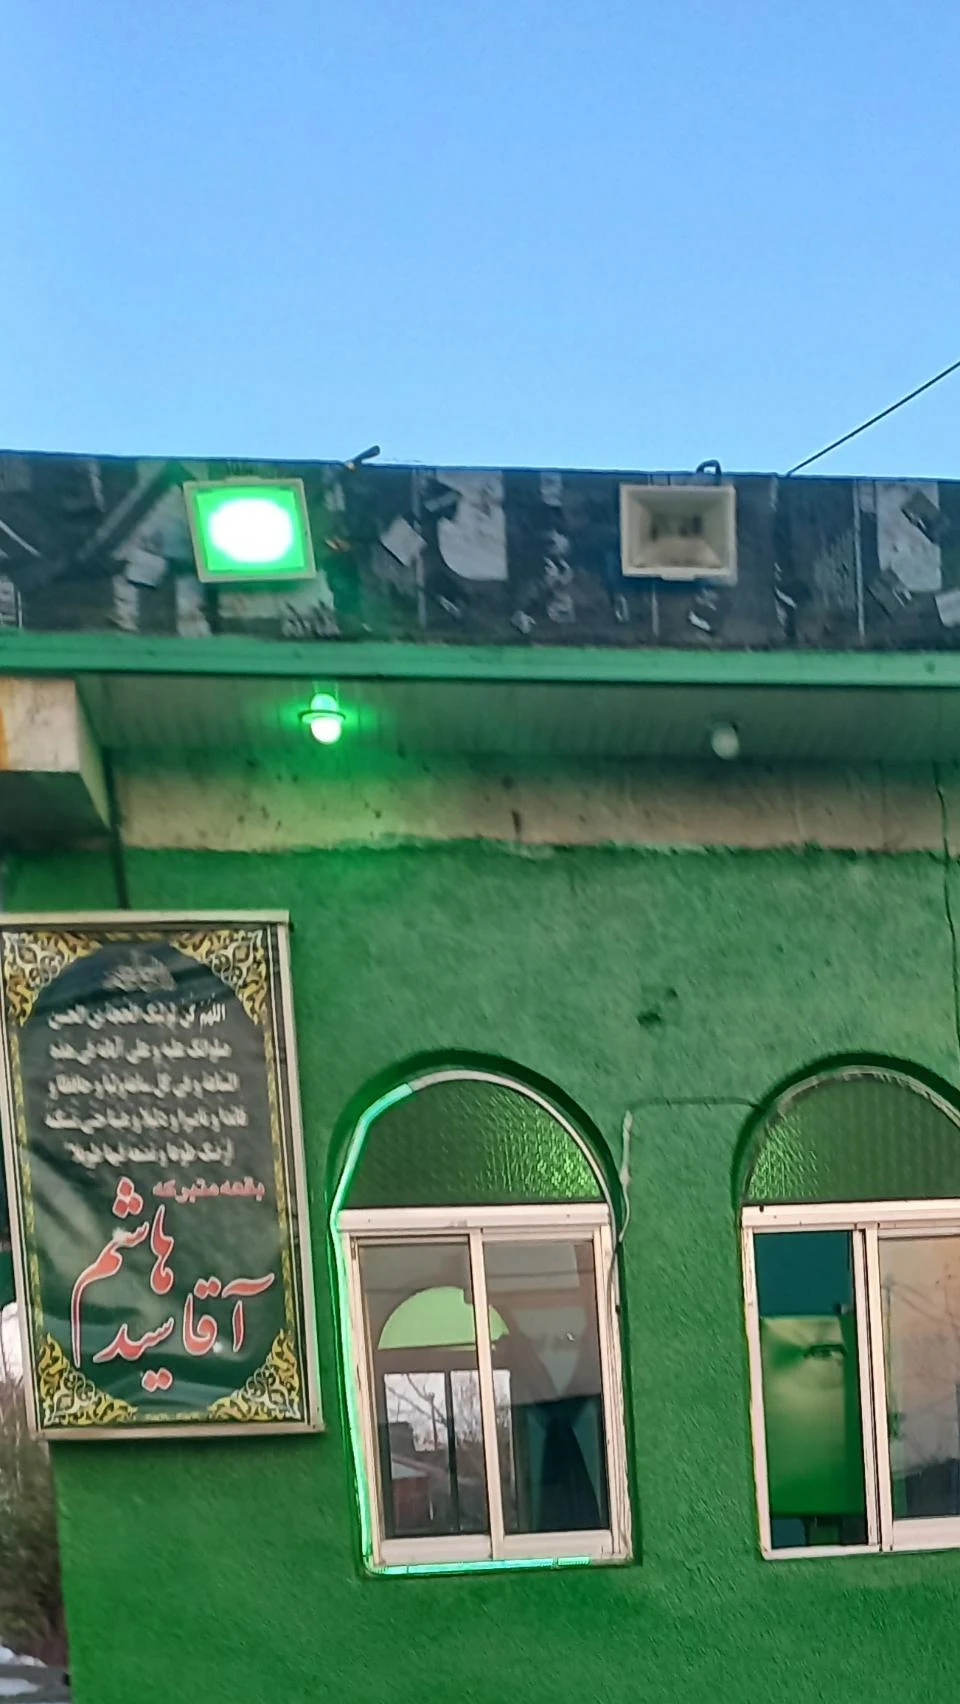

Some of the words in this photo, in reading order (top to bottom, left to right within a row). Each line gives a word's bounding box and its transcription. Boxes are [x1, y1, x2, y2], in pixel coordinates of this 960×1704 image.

[153, 1177, 220, 1203] متبرکه
[220, 1176, 265, 1201] بقعه
[71, 1176, 174, 1368] هاشم
[183, 1273, 275, 1356] آقا
[93, 1317, 174, 1392] سید
